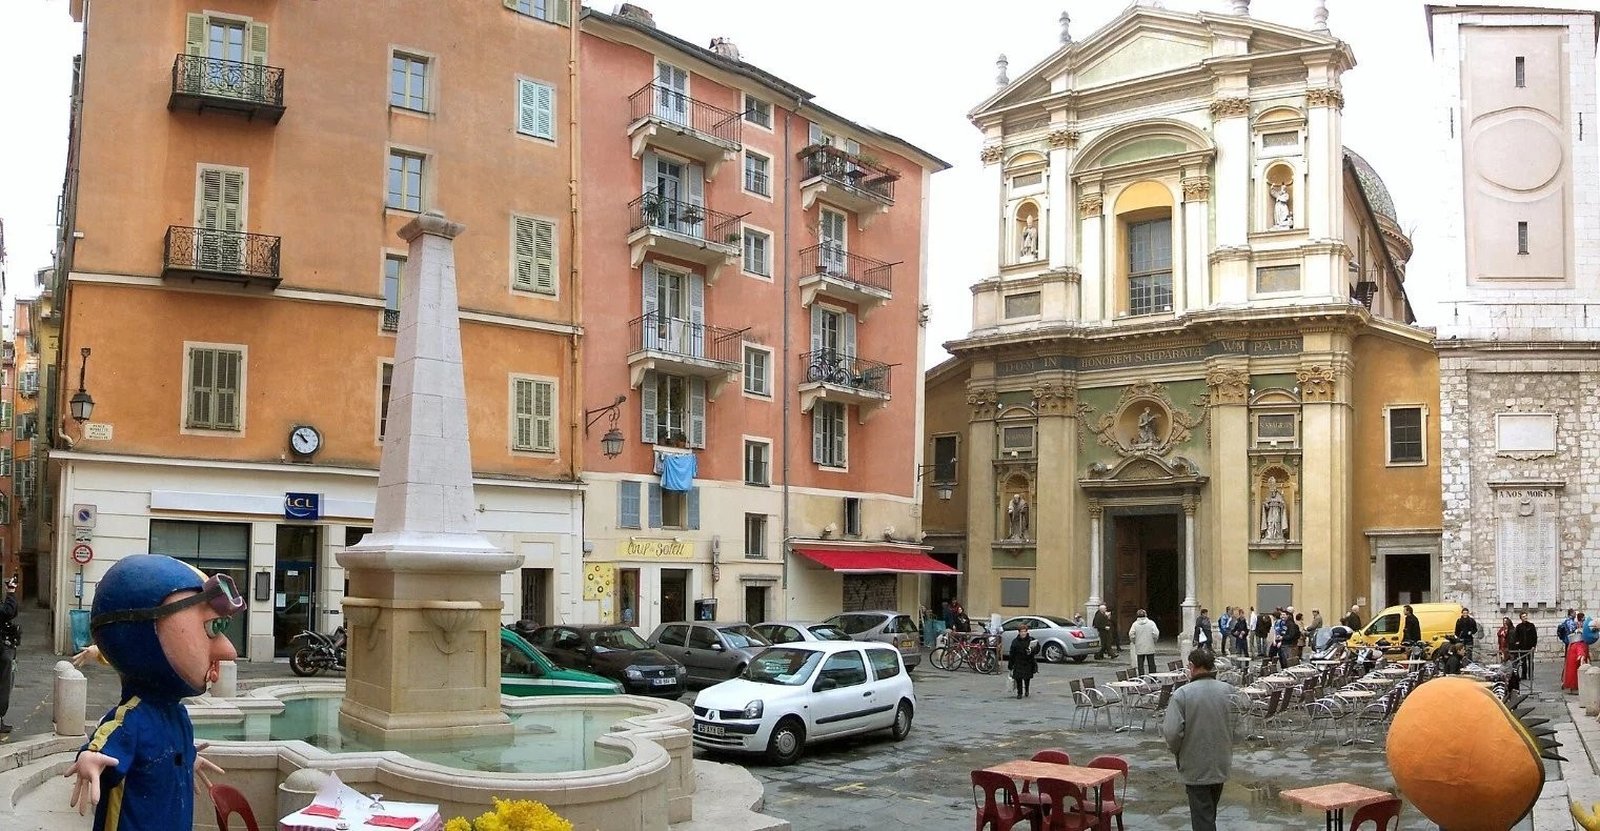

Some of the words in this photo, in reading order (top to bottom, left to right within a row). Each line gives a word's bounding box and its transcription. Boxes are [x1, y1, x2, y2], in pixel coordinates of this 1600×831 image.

[1043, 356, 1058, 367] IN
[1081, 354, 1132, 368] HONOREM
[1506, 490, 1523, 498] NOS
[1526, 490, 1554, 498] MORTS
[287, 497, 314, 508] LCL
